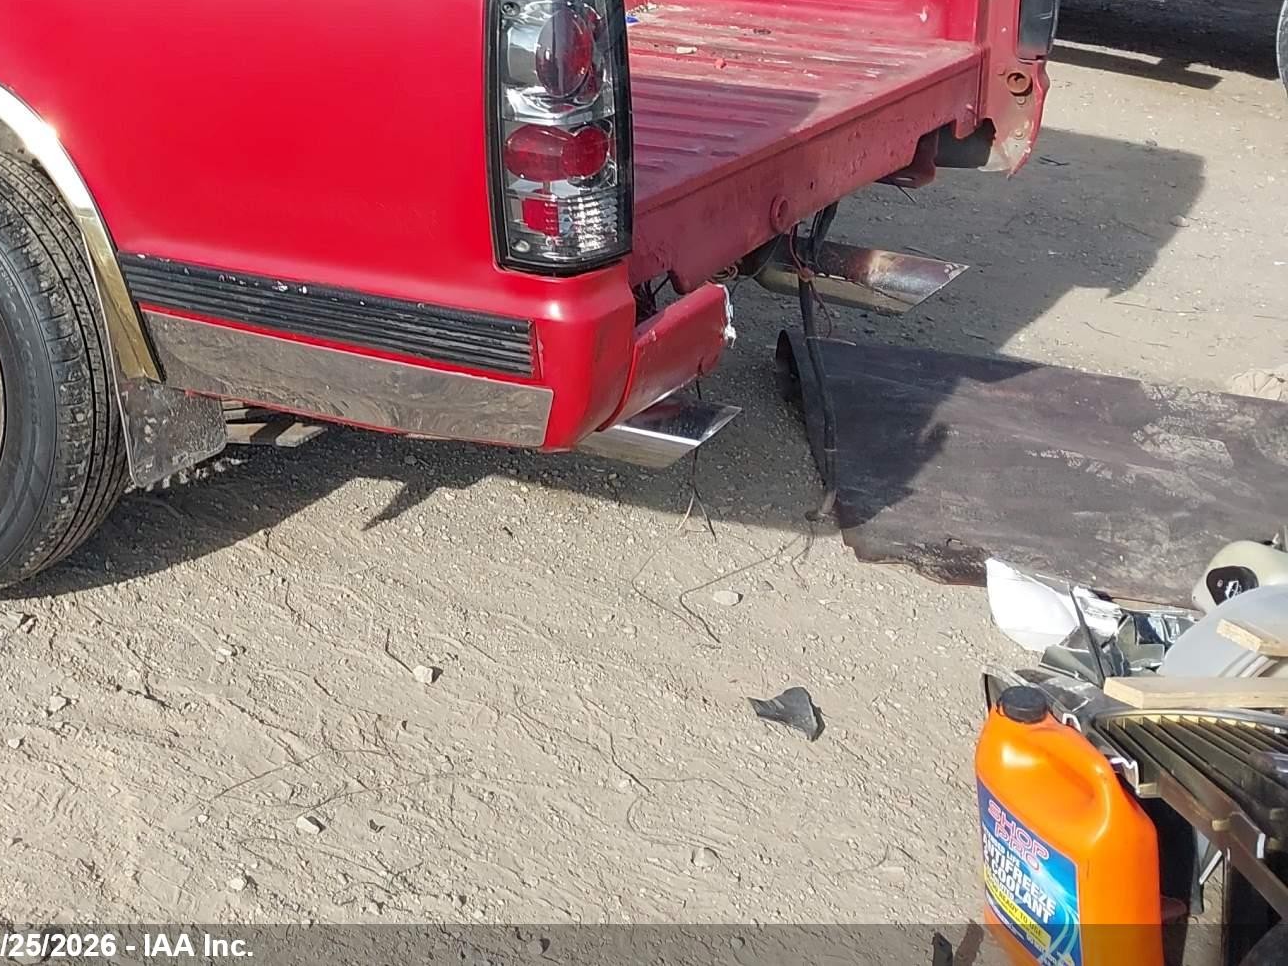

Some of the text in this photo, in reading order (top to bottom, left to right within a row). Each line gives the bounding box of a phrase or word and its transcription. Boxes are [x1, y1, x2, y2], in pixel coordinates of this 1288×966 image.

[988, 799, 1050, 860] SHOP
[994, 821, 1040, 872] PRO
[983, 833, 1056, 916] ANTIFREEZE
[992, 859, 1049, 924] COOLANT
